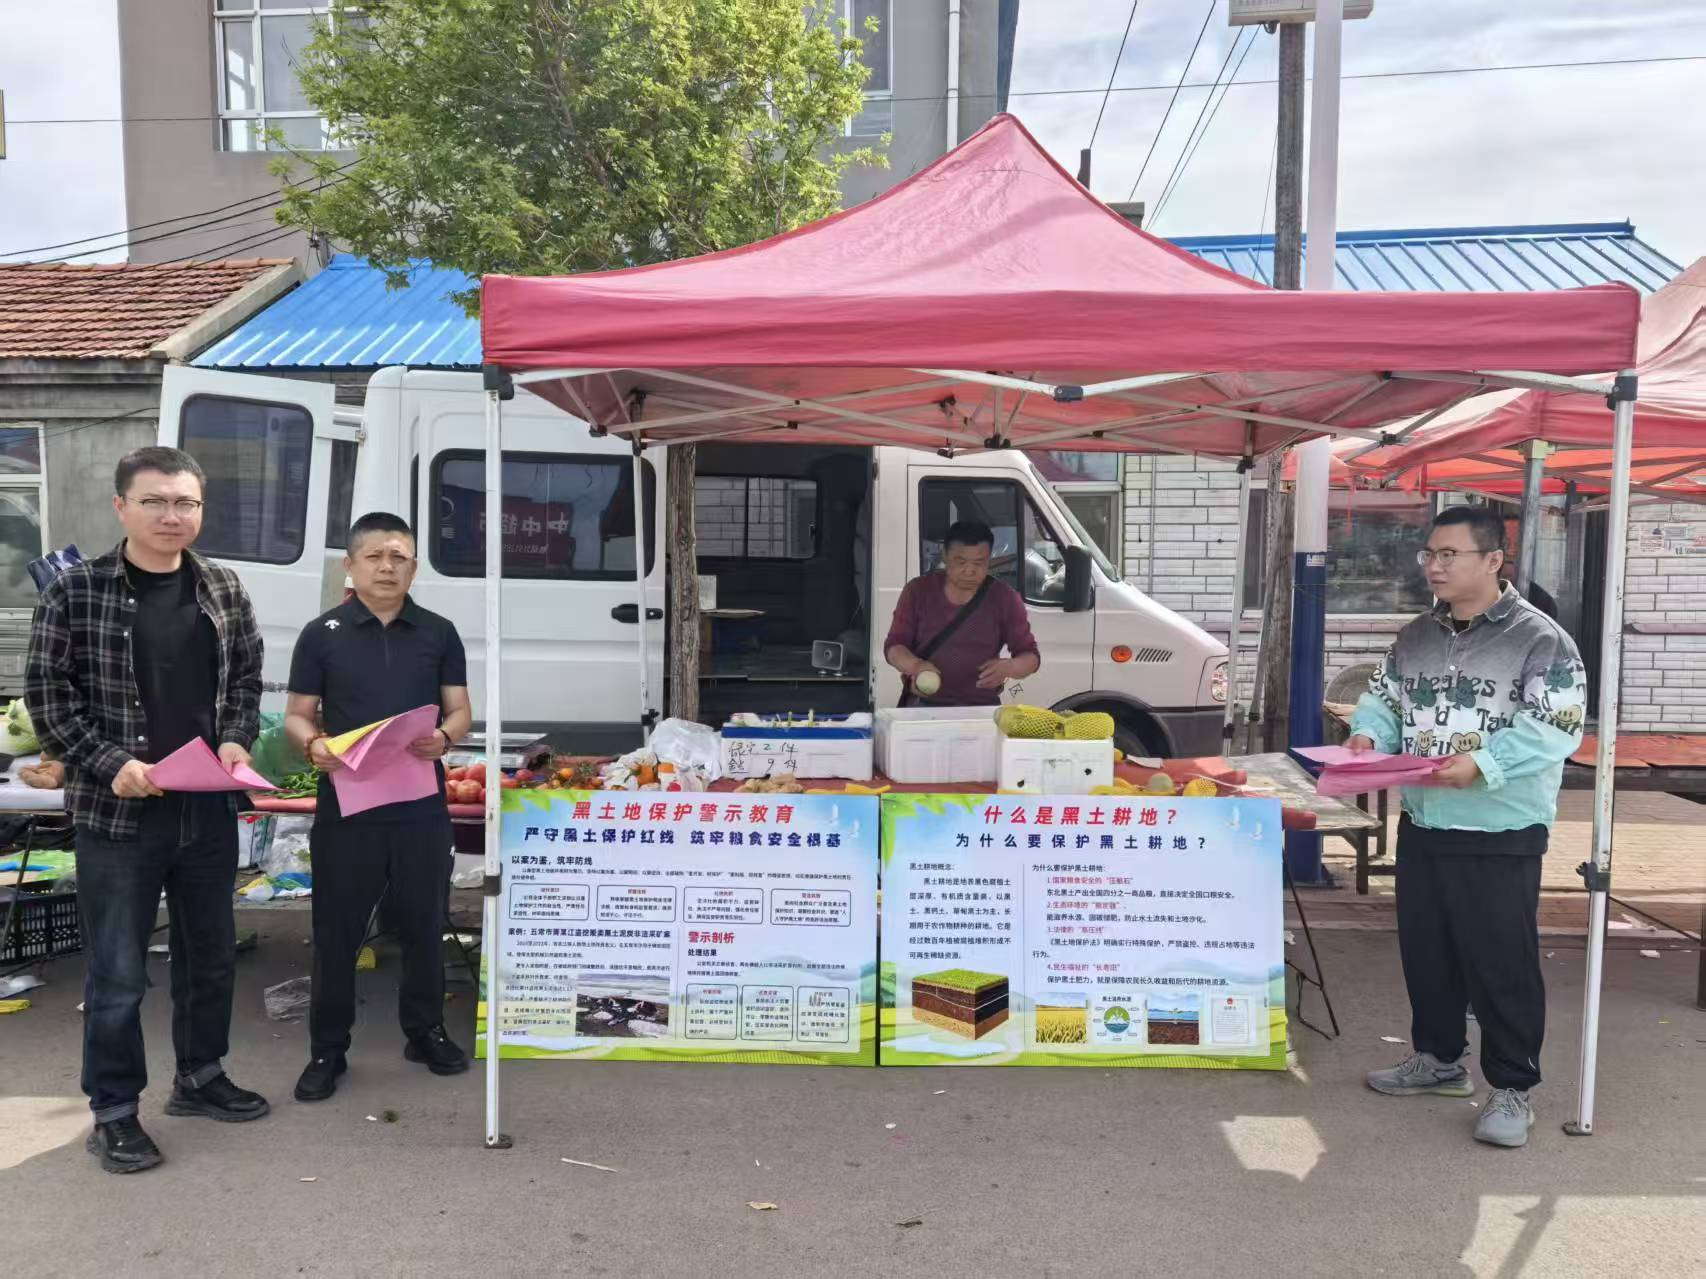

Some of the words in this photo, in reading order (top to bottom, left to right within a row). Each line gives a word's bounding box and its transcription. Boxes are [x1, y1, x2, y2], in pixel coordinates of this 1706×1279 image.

[572, 801, 796, 824] 黑土地保护警示教育
[984, 806, 1178, 826] 什么是黑土耕地？
[524, 828, 676, 844] 严守黑土保护红线
[690, 830, 842, 848] 筑牢粮食安全根基
[956, 832, 1206, 850] 为什么要保护黑土耕地？
[511, 856, 593, 866] 以案为鉴，筑牢防线
[688, 931, 735, 944] 警示剖析
[687, 948, 718, 957] 处理结果
[1032, 950, 1050, 959] 行为。
